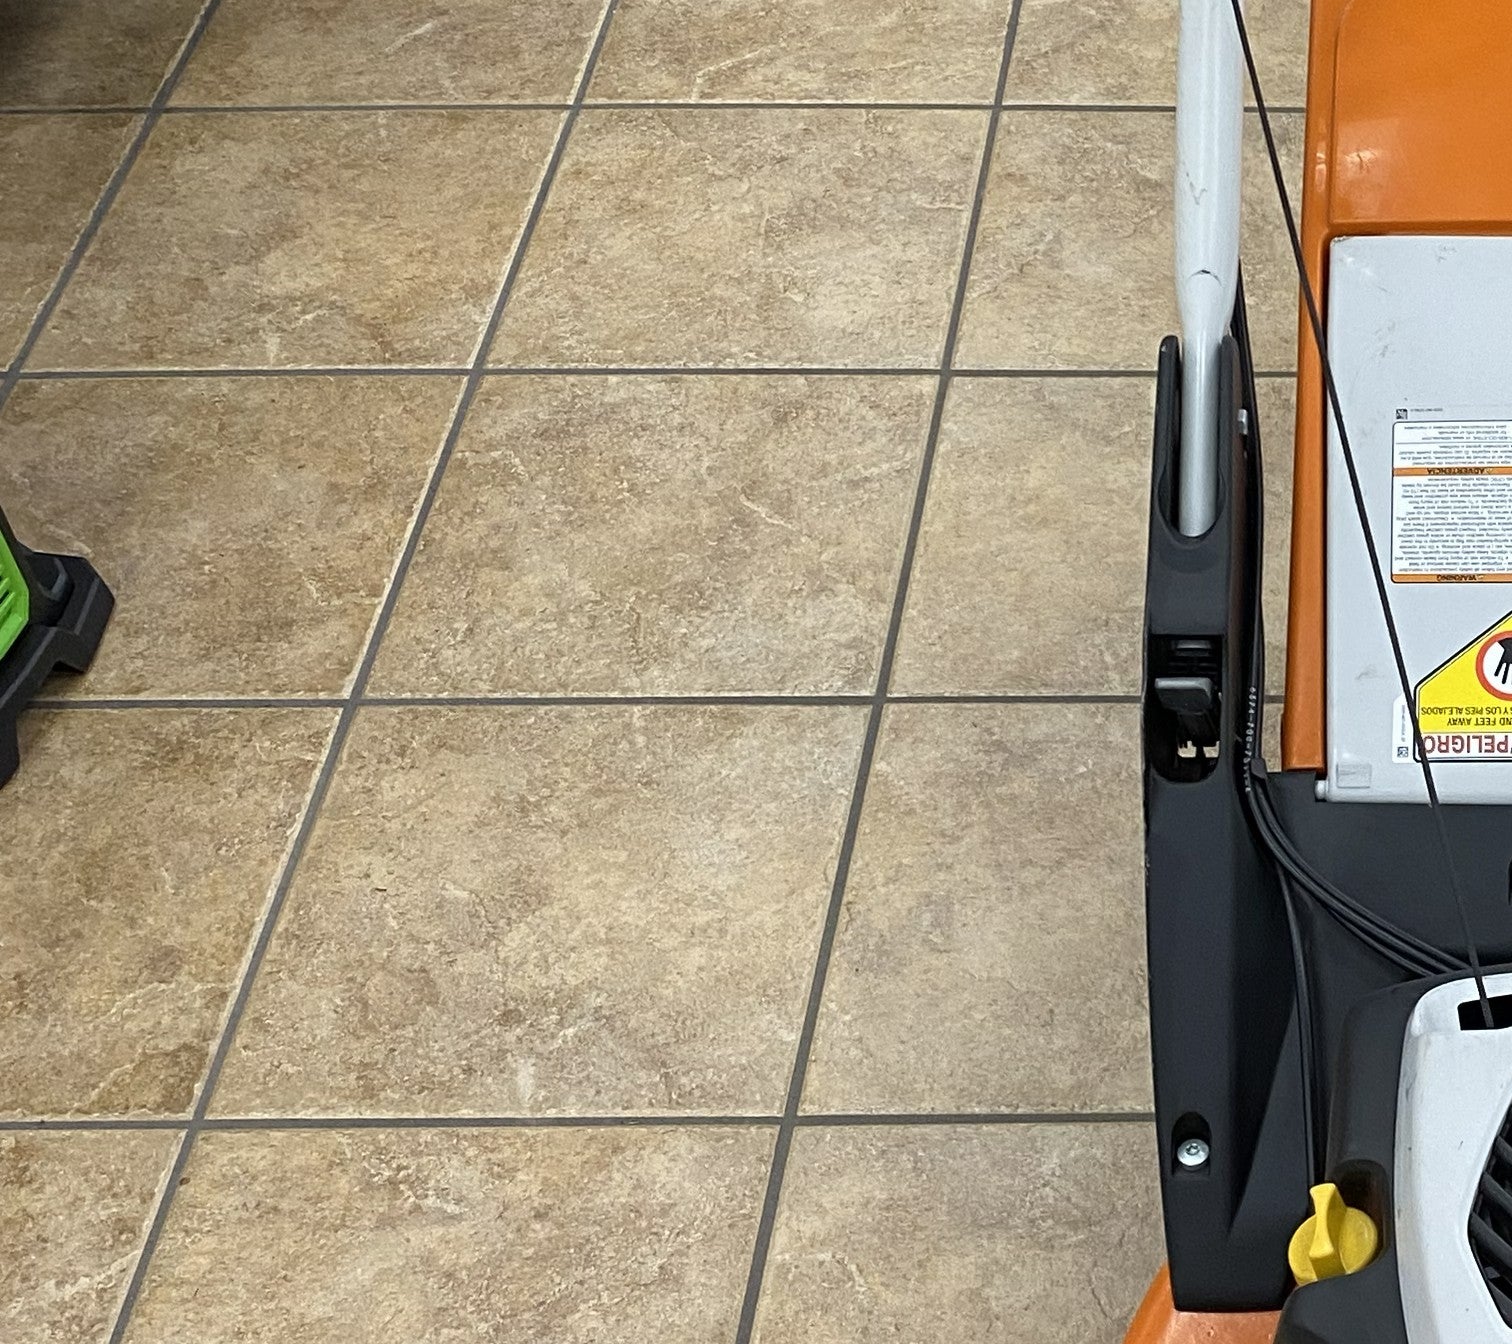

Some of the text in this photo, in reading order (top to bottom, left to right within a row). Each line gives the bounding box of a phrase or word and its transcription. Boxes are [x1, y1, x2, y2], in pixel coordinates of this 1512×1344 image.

[1420, 706, 1464, 715] ALEJADOS
[1465, 706, 1483, 715] PIES
[1485, 706, 1501, 715] LOS
[1503, 706, 1509, 715] Y
[1446, 717, 1472, 726] AWAY
[1474, 717, 1497, 726] FEET
